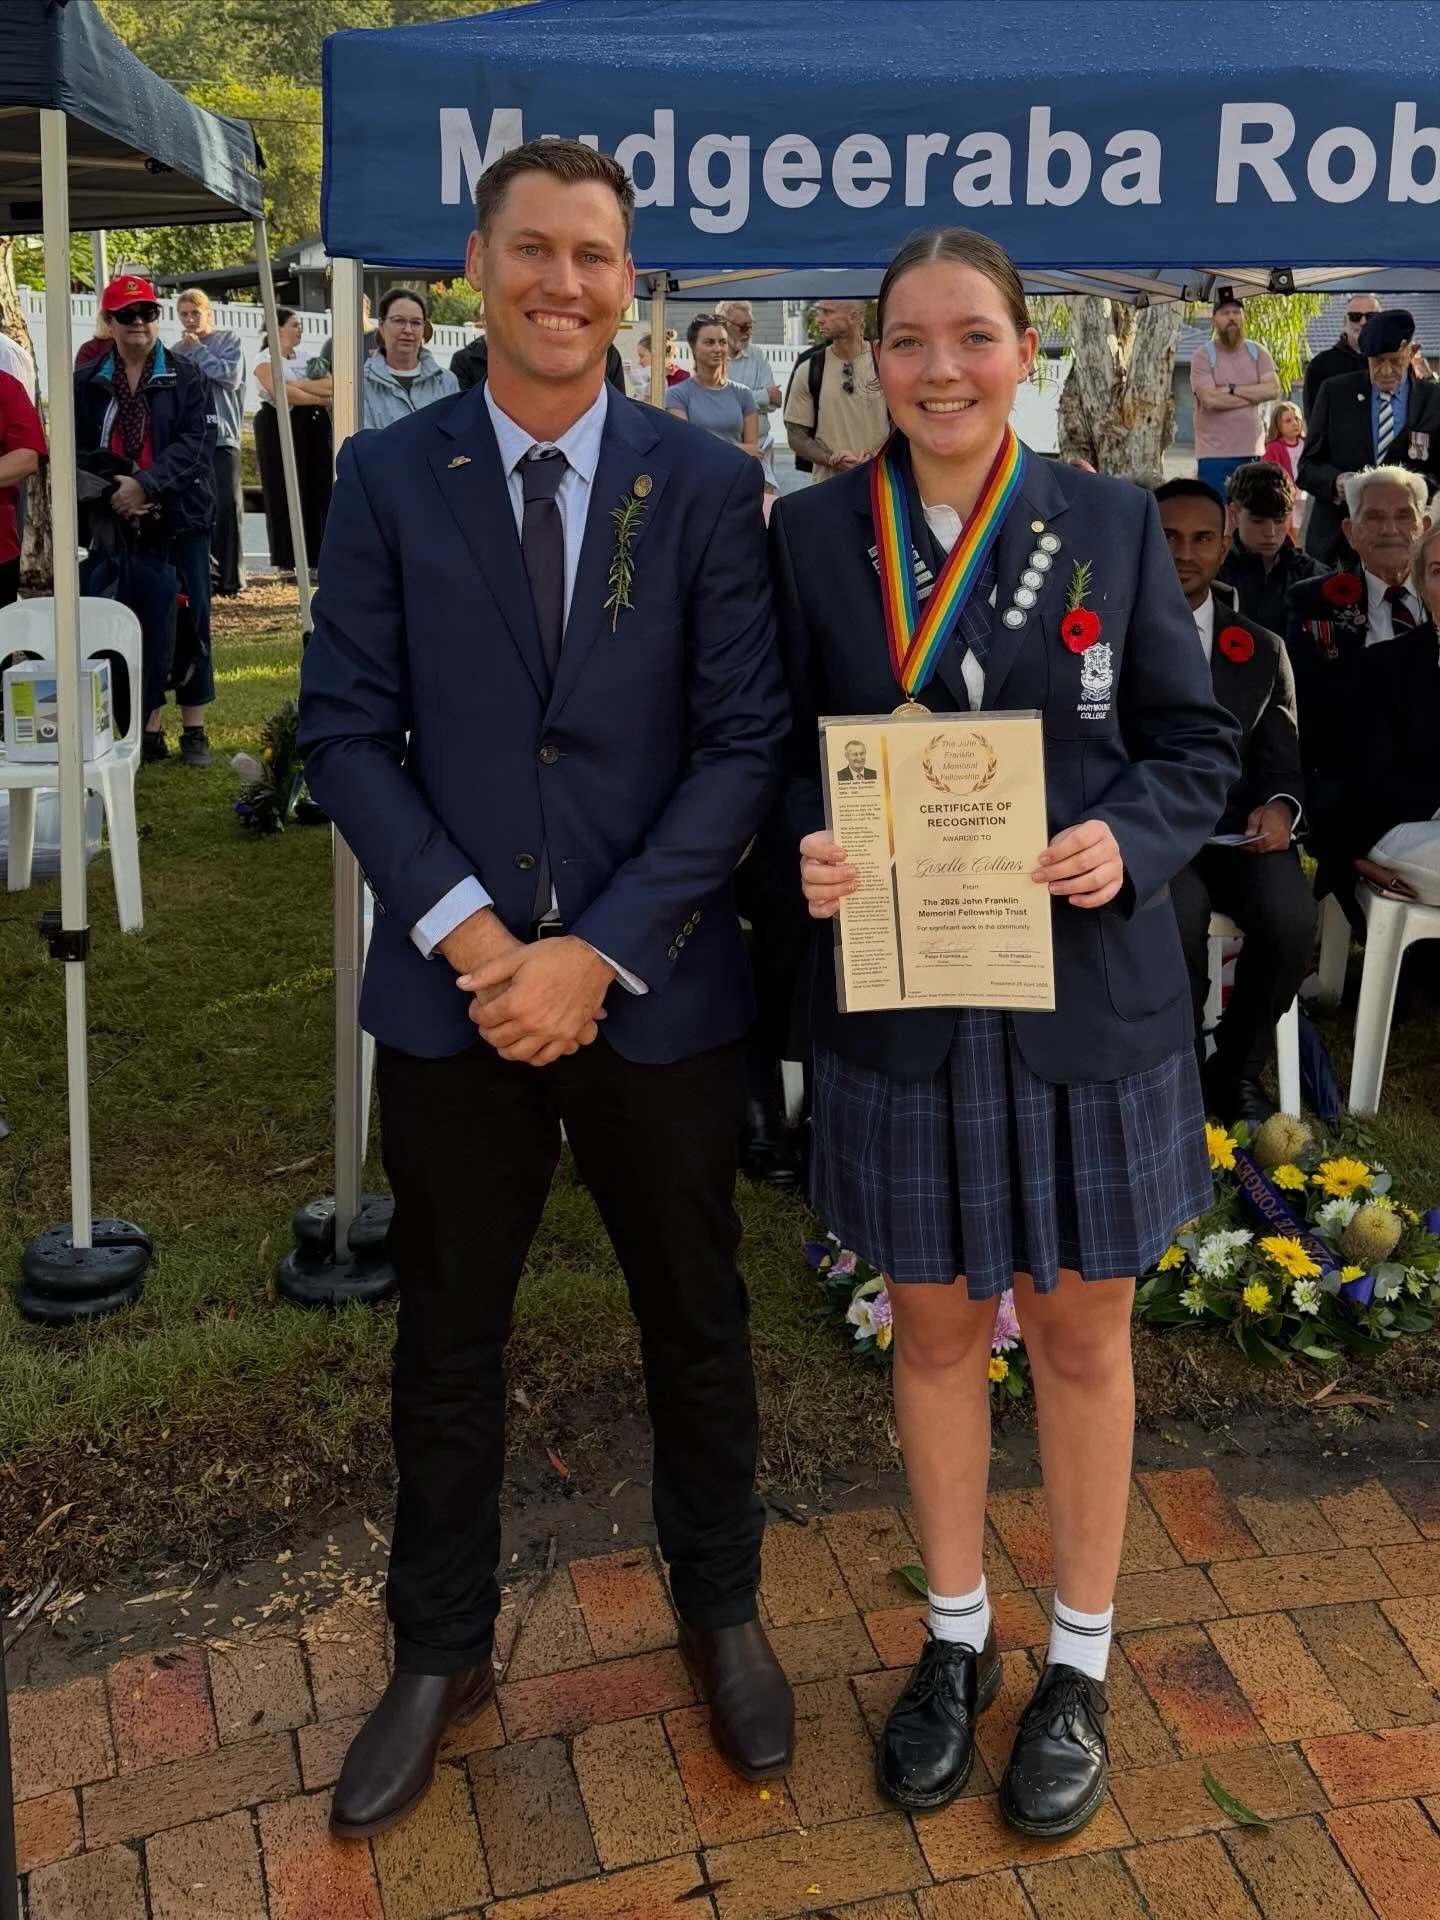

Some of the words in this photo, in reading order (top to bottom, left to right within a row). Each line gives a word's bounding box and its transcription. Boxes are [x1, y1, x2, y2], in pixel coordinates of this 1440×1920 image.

[440, 106, 1161, 234] Mdgeeraba
[1215, 102, 1440, 204] Rob
[1077, 703, 1111, 712] MARYMOUNT
[1080, 711, 1107, 720] COLLEGE
[942, 740, 956, 748] The
[958, 740, 976, 748] John
[944, 751, 975, 759] Franklin
[943, 762, 978, 770] Memorial
[940, 773, 980, 781] Fellowship
[920, 802, 993, 814] CERTIFICATE
[996, 801, 1012, 811] OF
[927, 816, 1006, 828] RECOGNITION
[942, 835, 980, 843] AWARDED
[916, 857, 967, 878] Giselle
[971, 855, 1024, 873] Collins
[940, 898, 960, 906] 2026
[962, 897, 983, 905] John
[985, 896, 1019, 905] Franklin
[918, 909, 956, 918] Memorial
[958, 908, 1003, 918] Fellowship
[1005, 907, 1028, 916] Trust
[929, 924, 960, 932] significant
